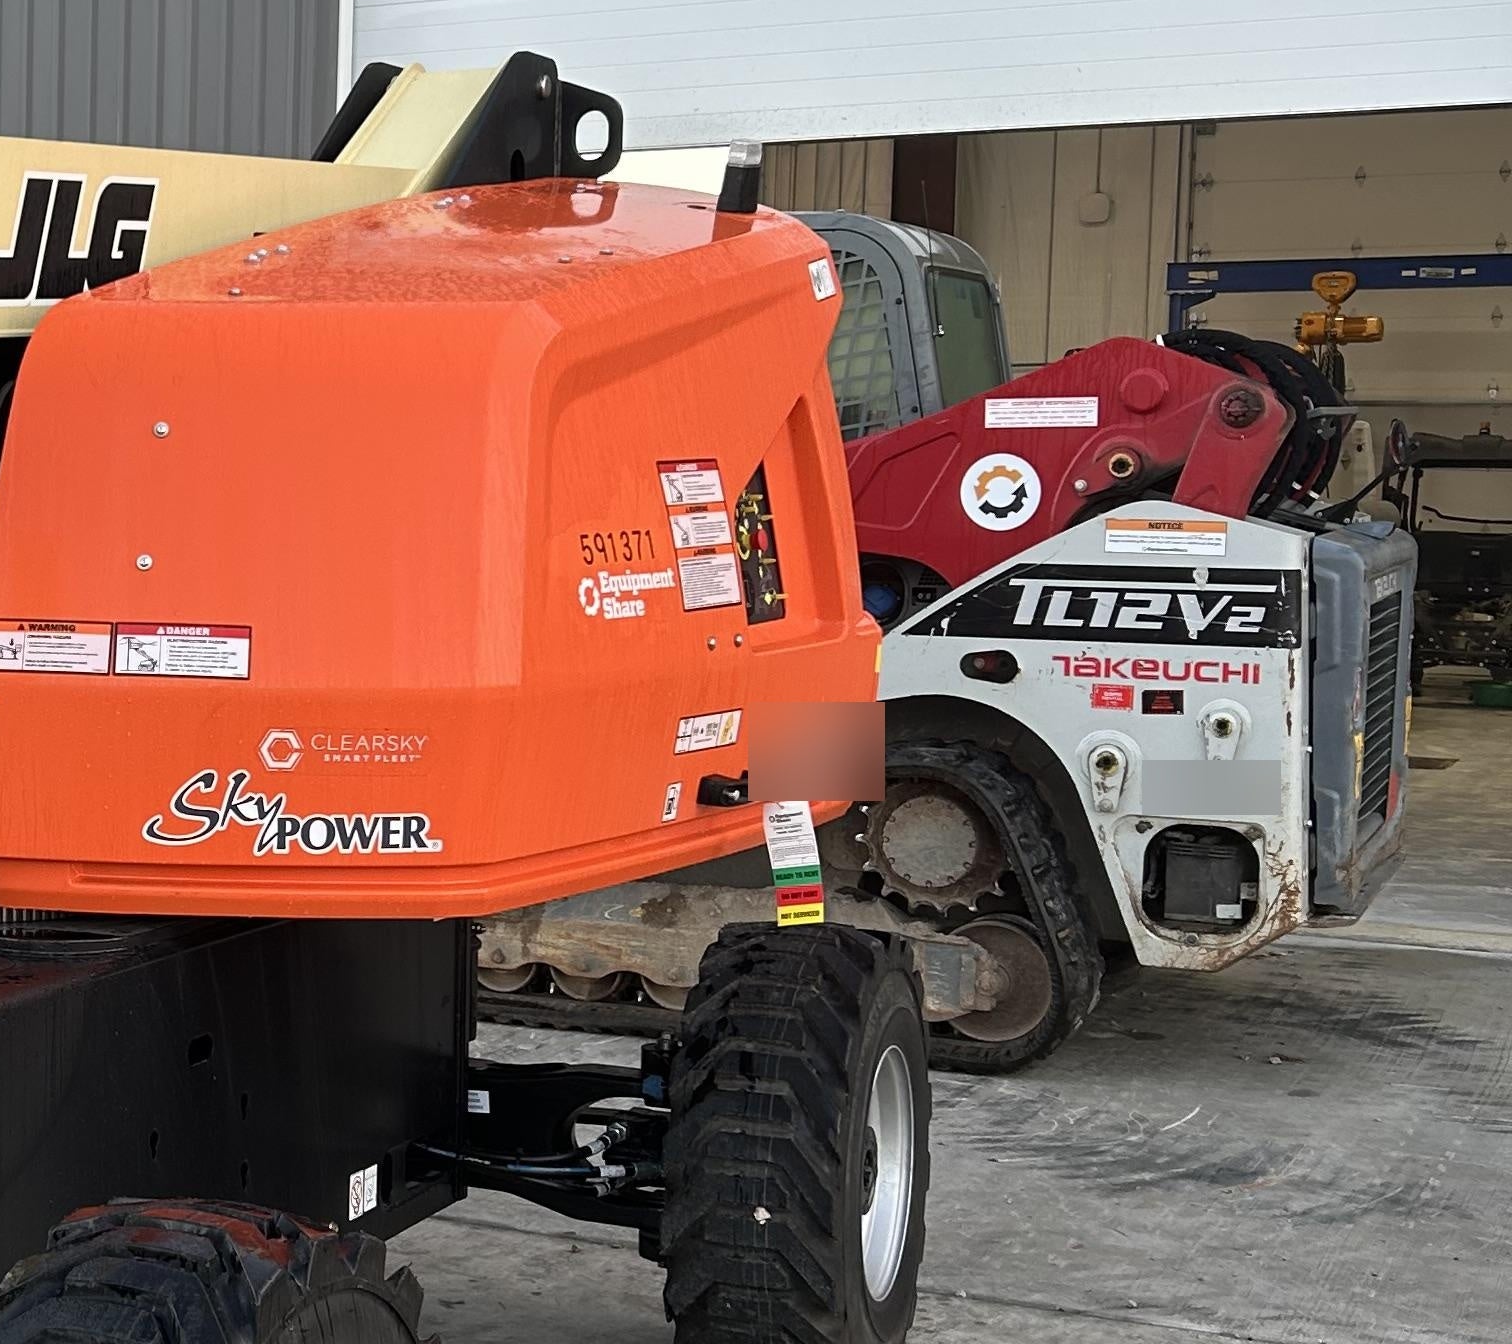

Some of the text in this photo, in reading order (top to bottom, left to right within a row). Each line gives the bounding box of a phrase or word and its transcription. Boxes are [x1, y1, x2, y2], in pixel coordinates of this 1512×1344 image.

[579, 529, 655, 565] 591371
[598, 568, 676, 597] Equipment
[603, 598, 645, 620] Share
[28, 624, 76, 632] WARNING
[166, 626, 210, 636] DANGER
[311, 734, 427, 752] CLEARSKY
[323, 754, 370, 763] SMART
